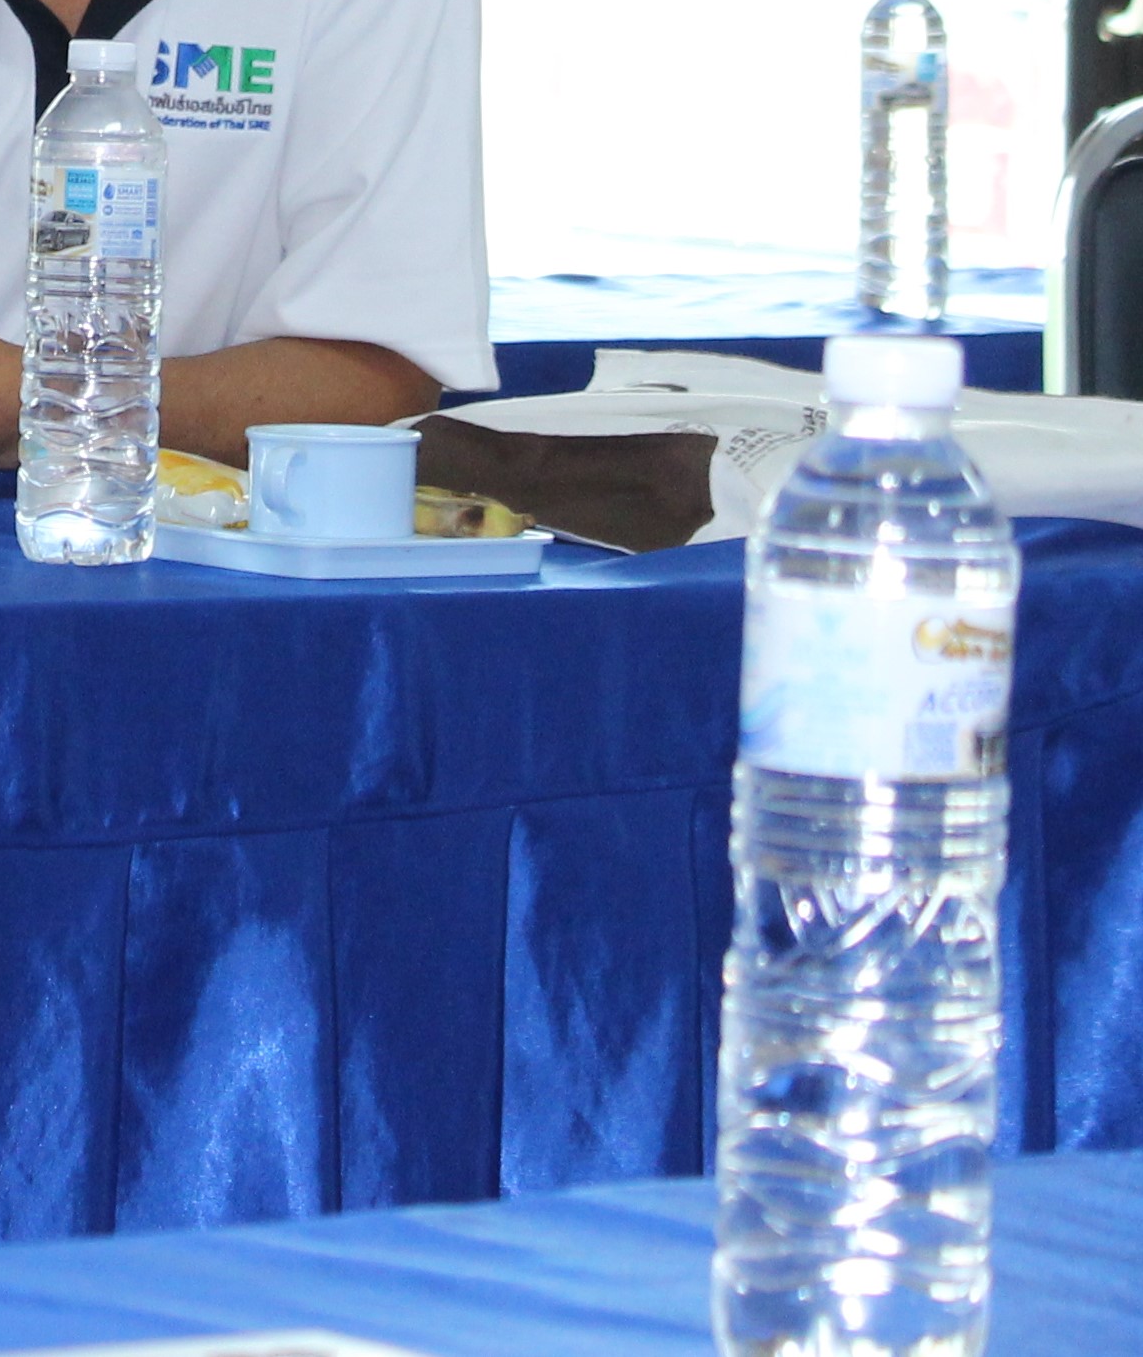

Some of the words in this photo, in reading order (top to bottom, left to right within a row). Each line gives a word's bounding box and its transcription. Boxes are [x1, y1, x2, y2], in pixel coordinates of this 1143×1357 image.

[158, 116, 207, 129] deration
[209, 119, 221, 129] of
[224, 119, 245, 130] Thai
[248, 120, 270, 131] SME
